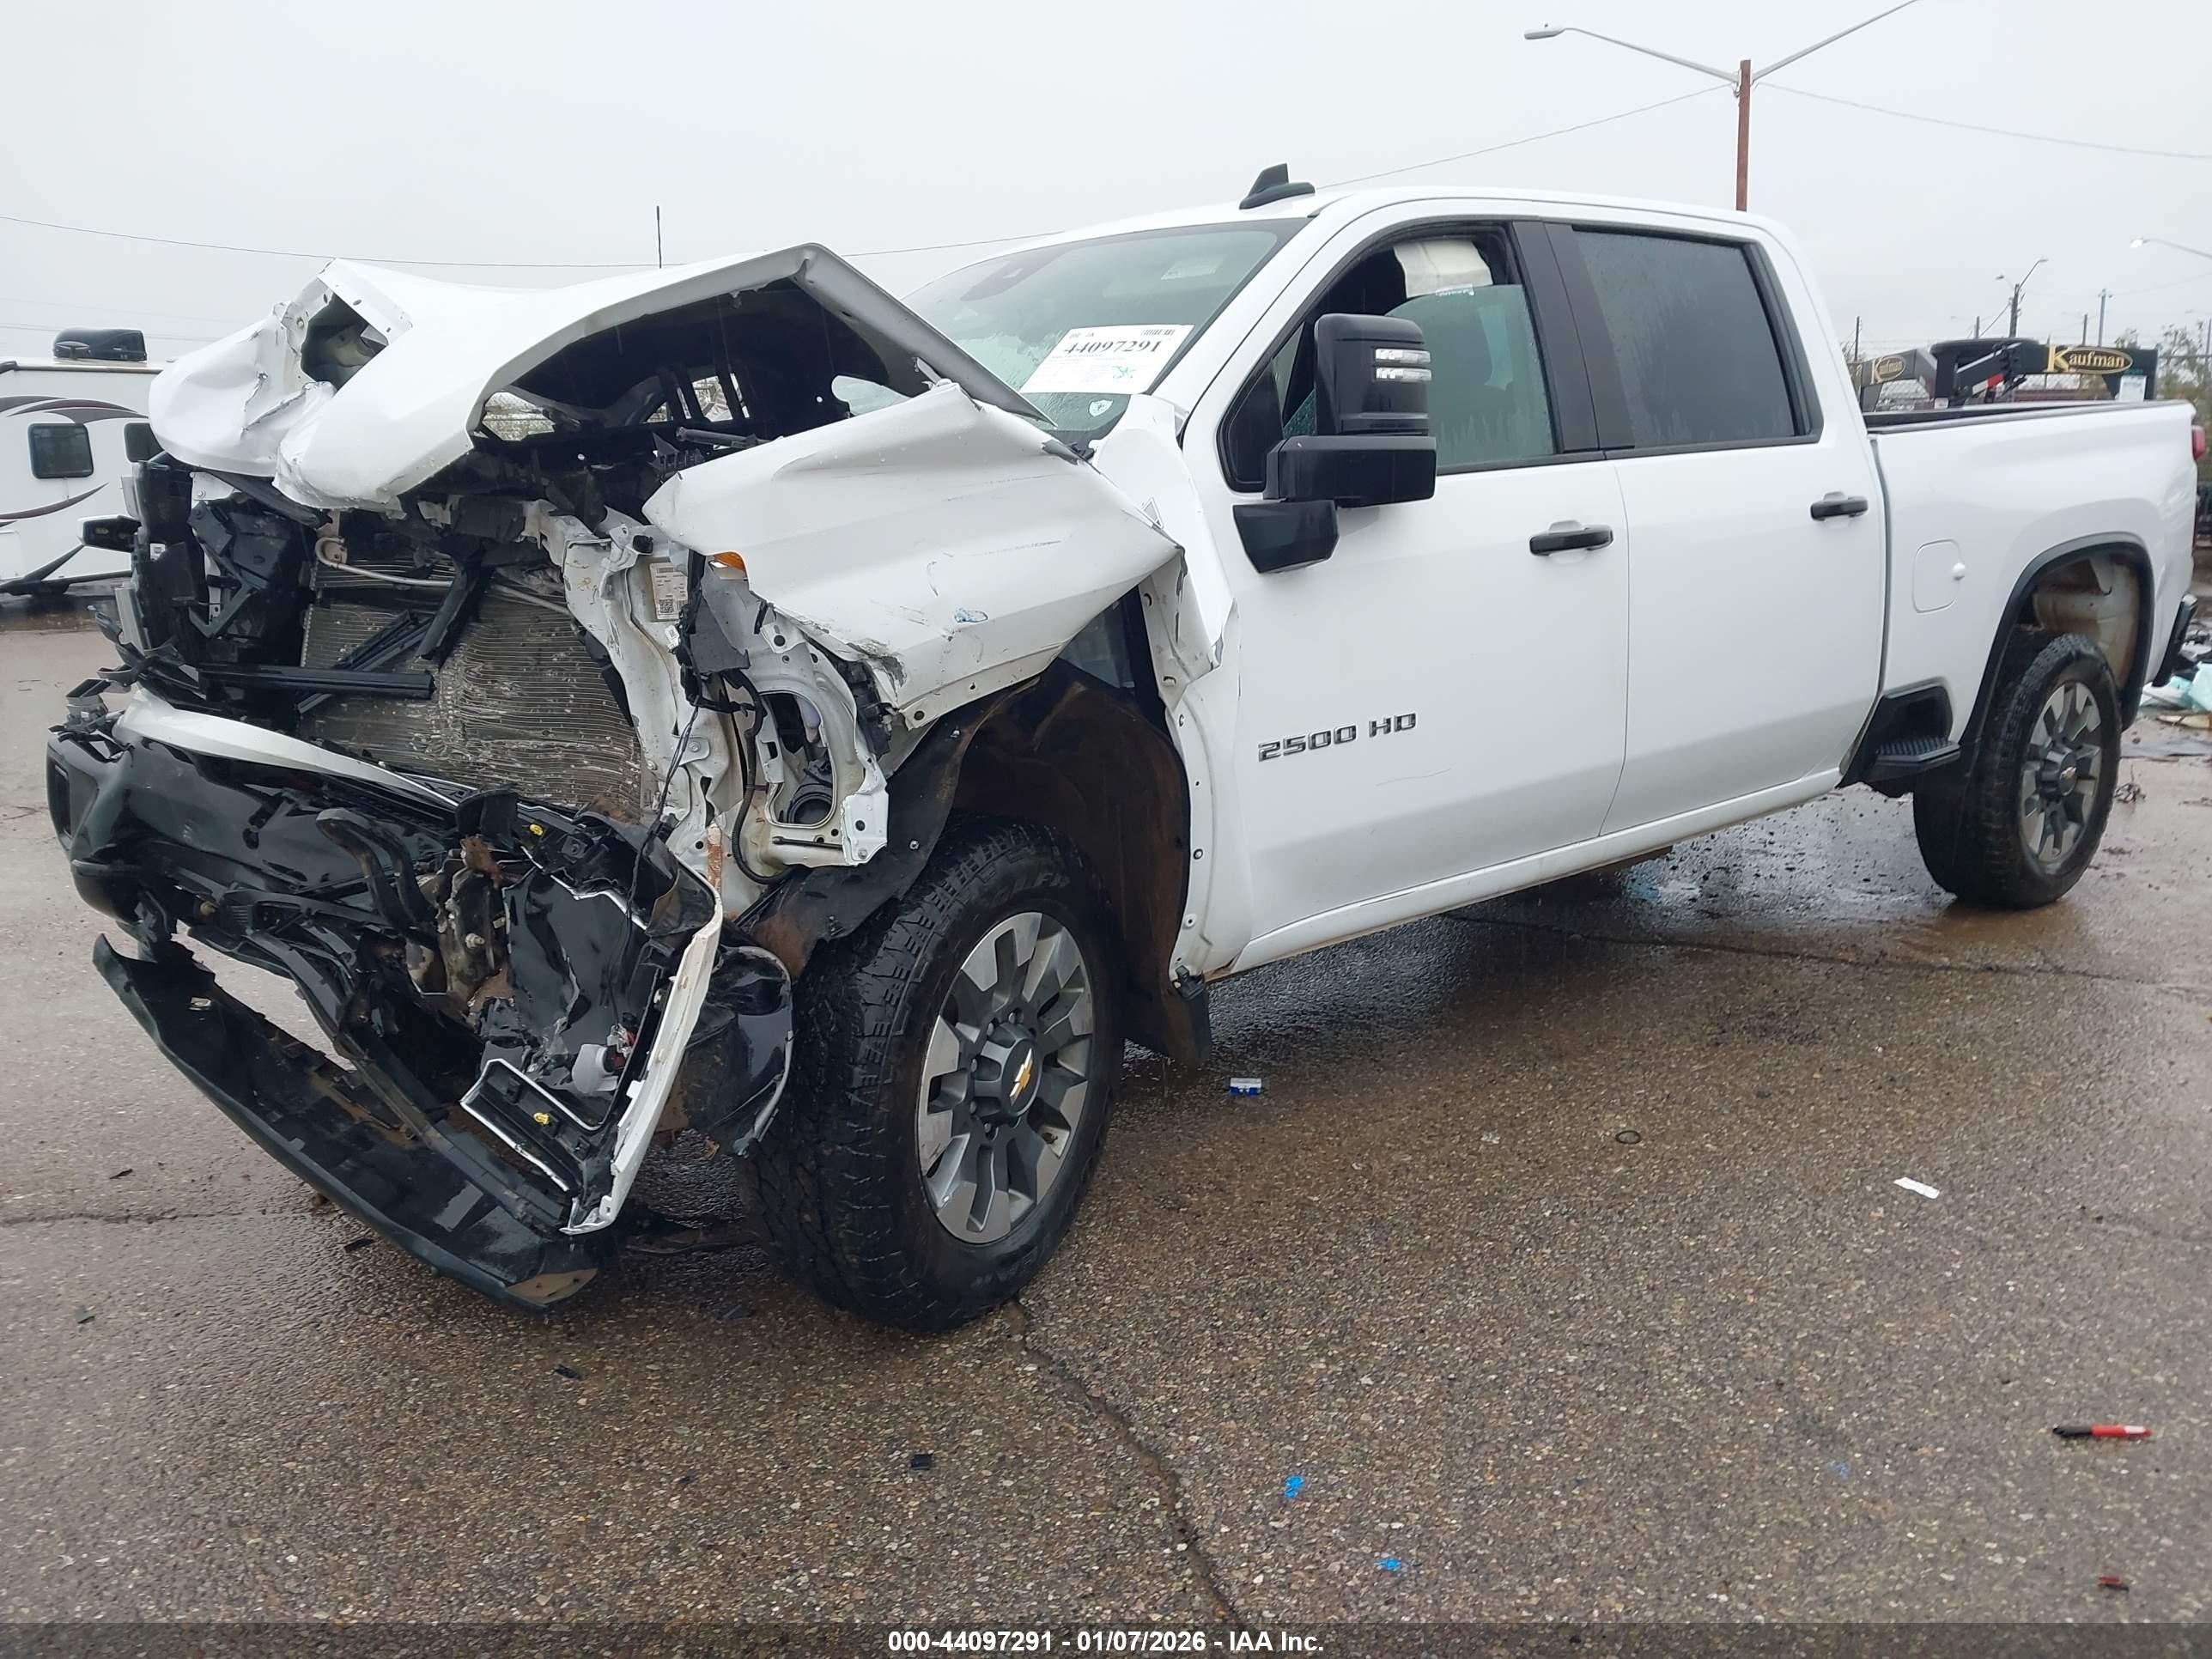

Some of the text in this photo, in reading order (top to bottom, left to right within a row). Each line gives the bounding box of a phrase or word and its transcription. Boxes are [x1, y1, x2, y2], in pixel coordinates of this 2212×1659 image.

[1064, 340, 1162, 354] 44097291
[2044, 343, 2125, 373] Kaufman
[1258, 712, 1417, 762] 2500 HD
